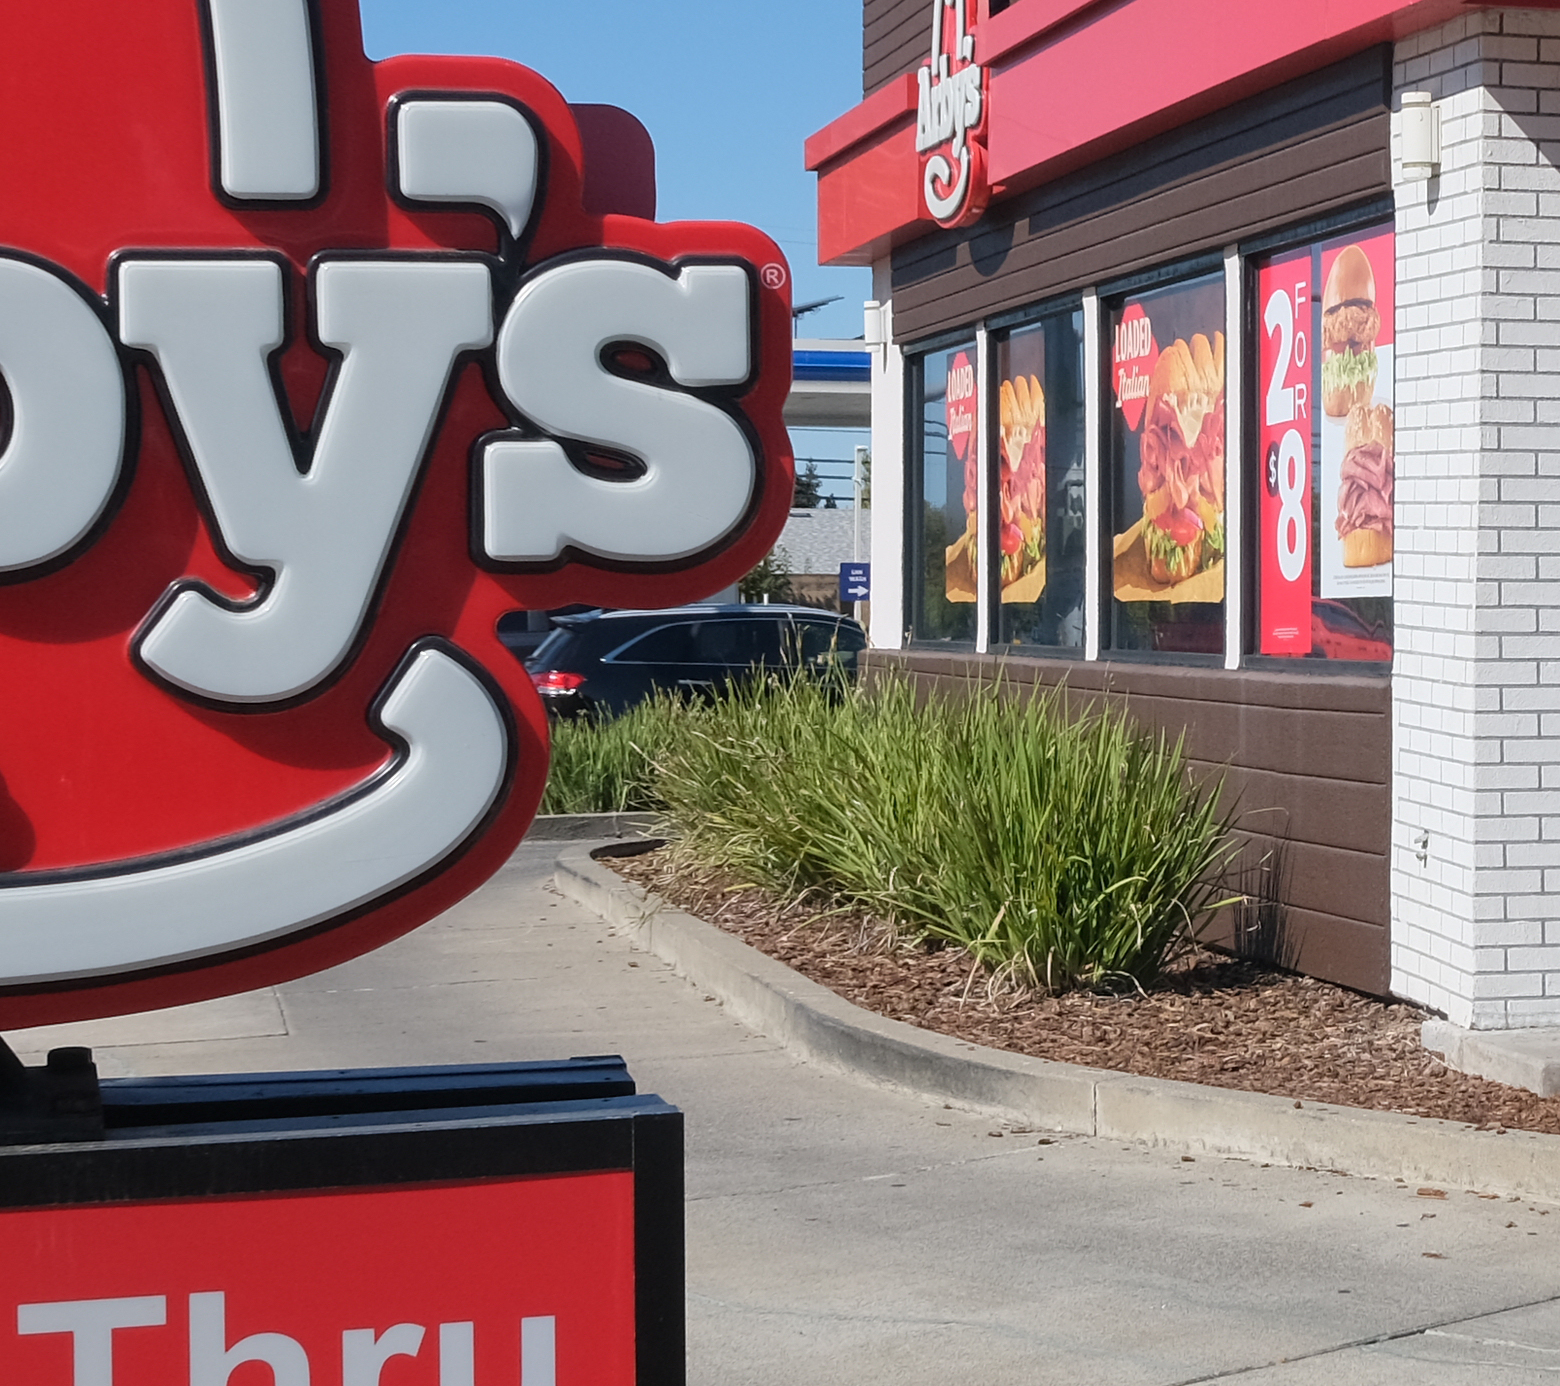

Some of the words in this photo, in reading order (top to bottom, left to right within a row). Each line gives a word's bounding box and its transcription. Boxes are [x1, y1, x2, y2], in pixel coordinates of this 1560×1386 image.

[1115, 317, 1152, 363] LOADED
[1264, 289, 1294, 426] 2
[947, 365, 974, 403] LOADED
[1115, 365, 1150, 409] Italian
